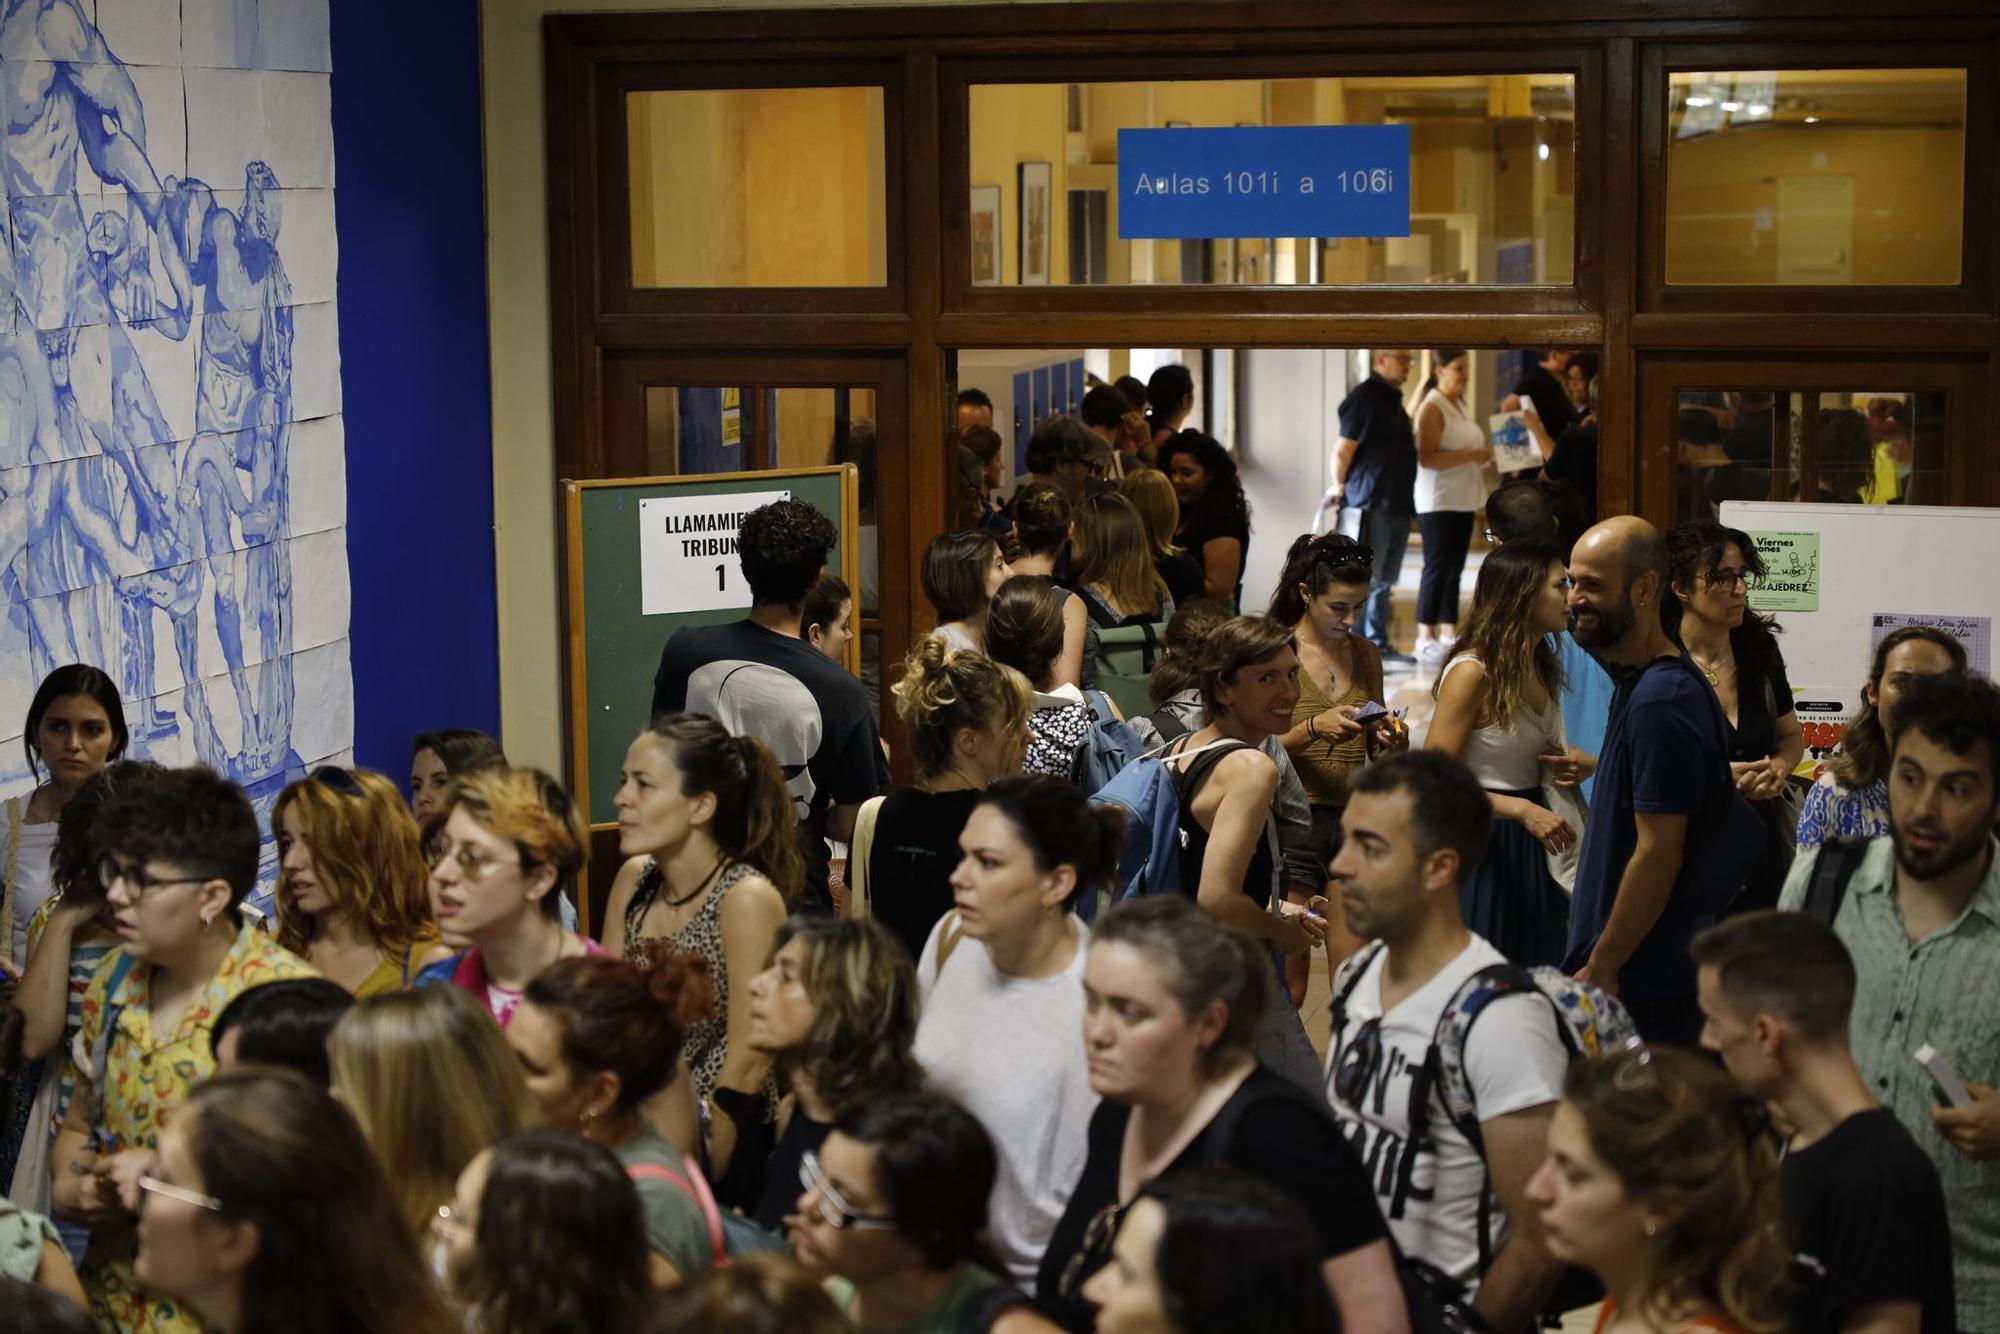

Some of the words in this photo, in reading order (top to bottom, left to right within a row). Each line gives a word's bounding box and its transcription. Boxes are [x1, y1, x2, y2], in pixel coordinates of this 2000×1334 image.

[1134, 172, 1210, 195] Aulas
[1223, 171, 1279, 194] 101i
[1300, 175, 1315, 193] a
[1336, 168, 1394, 194] 106i
[665, 511, 746, 534] LLAMAMIE
[681, 537, 740, 558] TRIBUN
[1756, 537, 1794, 547] Viernes
[714, 564, 726, 592] 1
